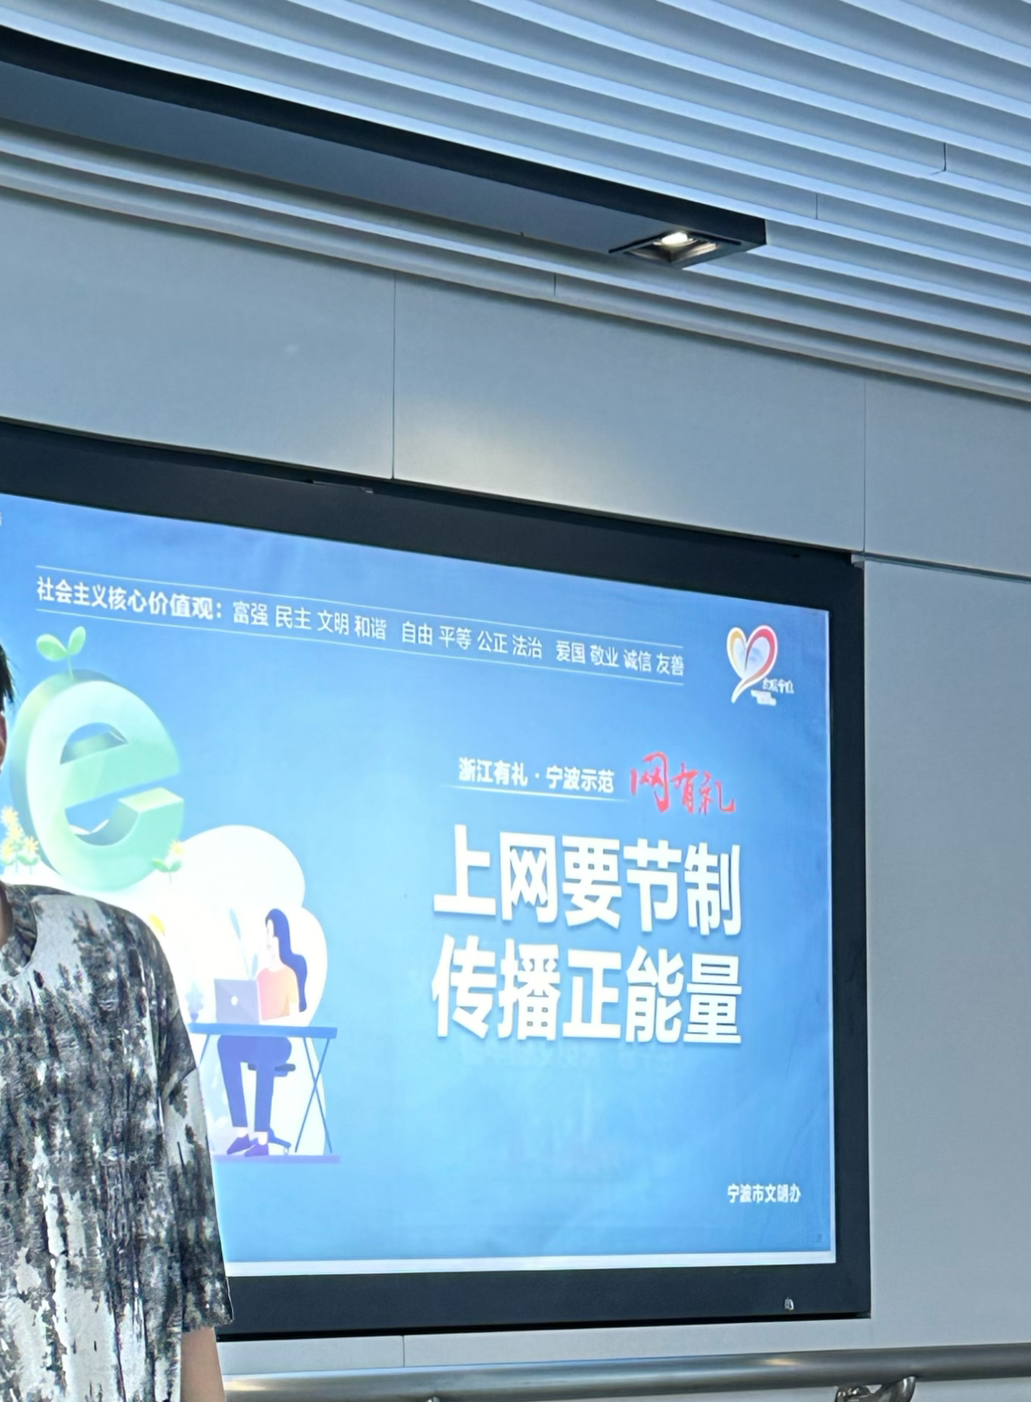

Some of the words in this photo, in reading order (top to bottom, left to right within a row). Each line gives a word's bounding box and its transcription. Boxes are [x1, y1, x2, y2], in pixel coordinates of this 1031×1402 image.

[233, 601, 269, 627] 富强
[275, 605, 312, 630] 民主
[317, 610, 350, 635] 文明
[354, 615, 387, 641] 和谐
[402, 621, 433, 646] 自由
[439, 625, 472, 650] 平等
[477, 630, 508, 654] 公正
[512, 634, 543, 659] 法治
[556, 640, 586, 665] 爱国
[590, 644, 620, 668] 敬业
[623, 649, 652, 673] 诚信
[656, 653, 684, 677] 友善
[433, 824, 742, 936] 上网要节制
[431, 933, 743, 1045] 传播正能量
[727, 1183, 802, 1204] 宁波市文明办
